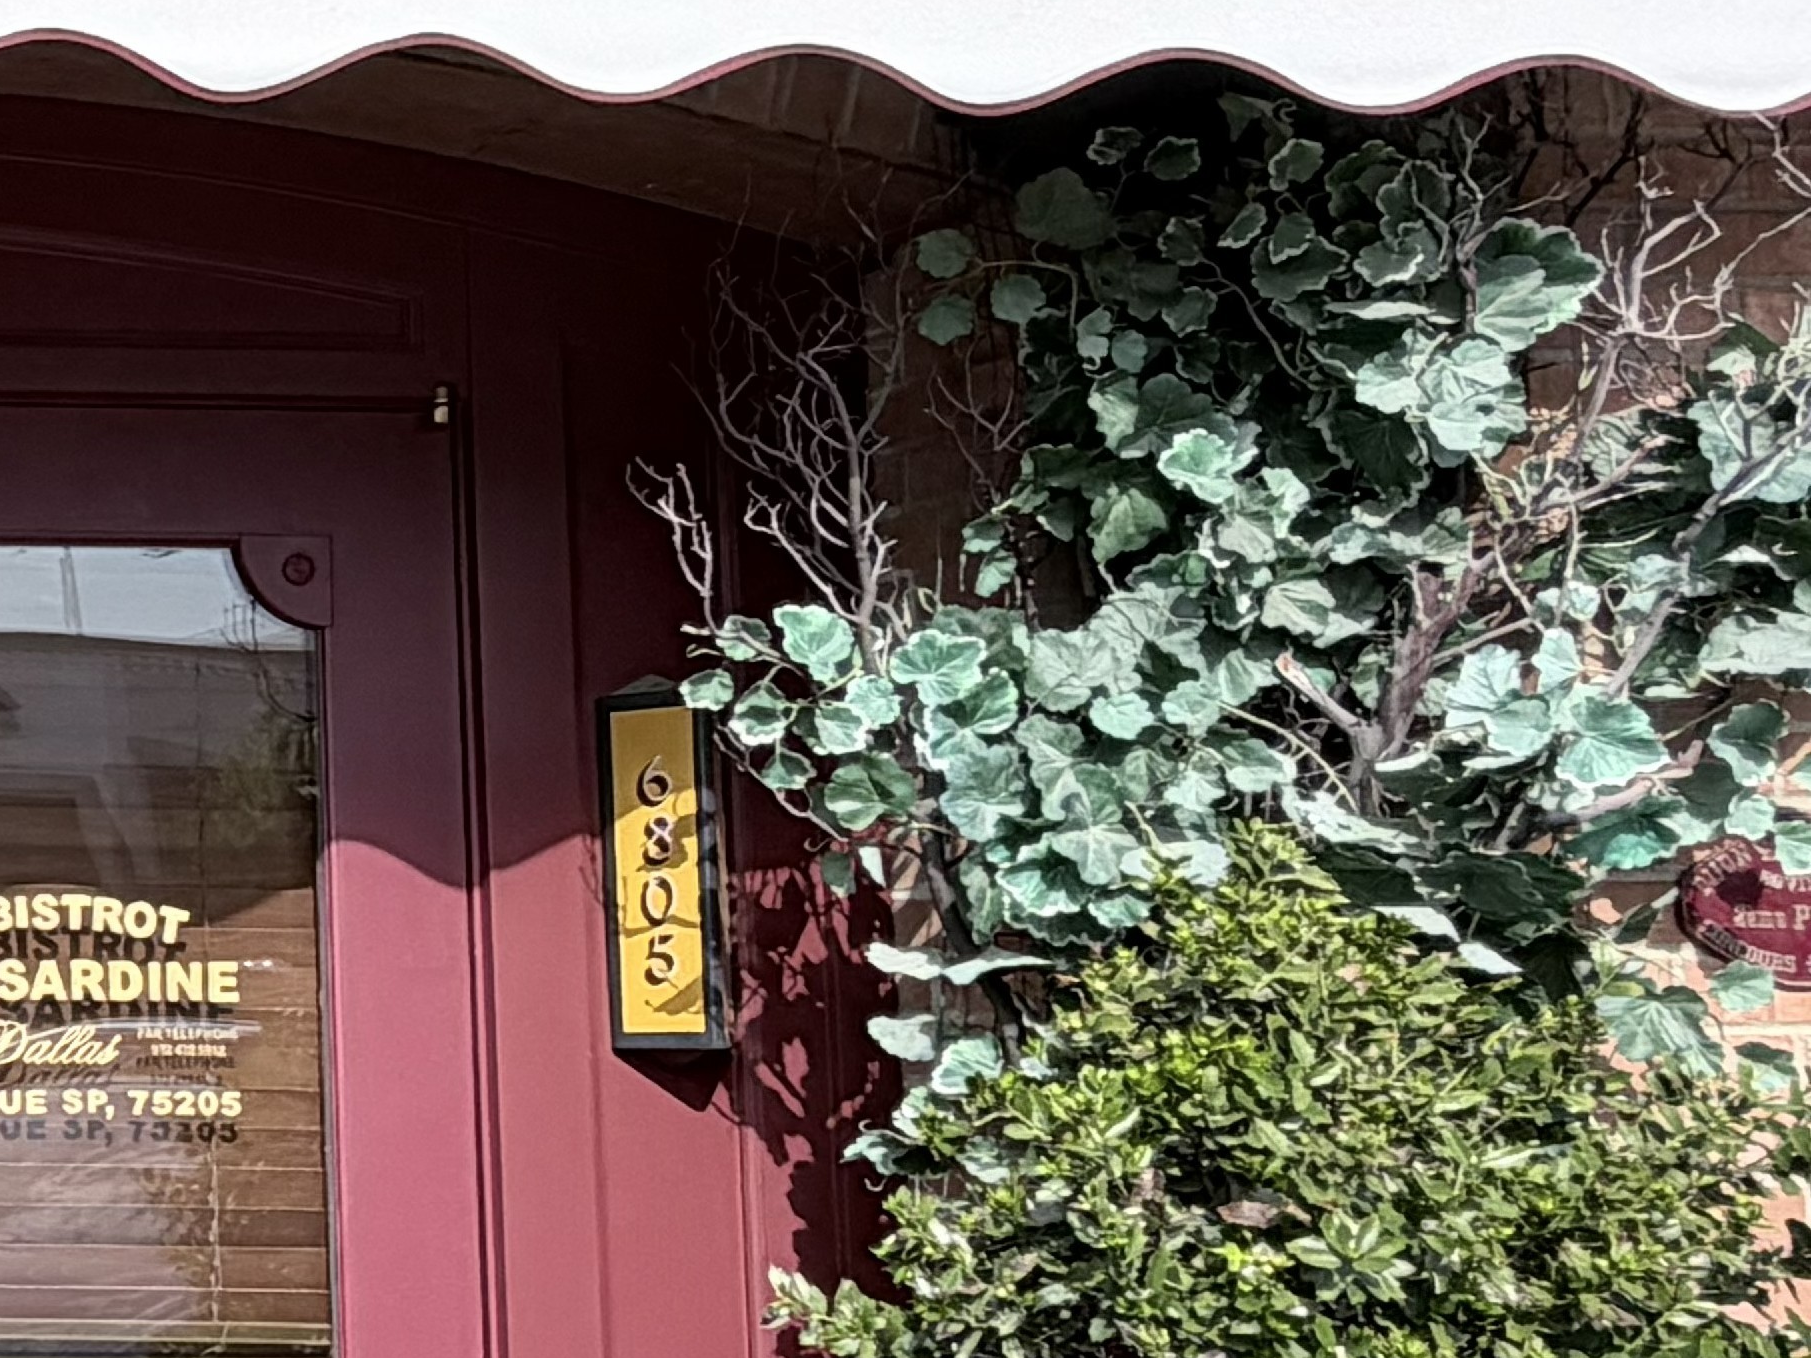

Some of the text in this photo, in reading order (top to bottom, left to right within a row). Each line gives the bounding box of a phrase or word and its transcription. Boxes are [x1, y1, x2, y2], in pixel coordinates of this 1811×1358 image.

[636, 755, 676, 986] 6805
[61, 1089, 116, 1121] SP,
[127, 1089, 243, 1117] 75205
